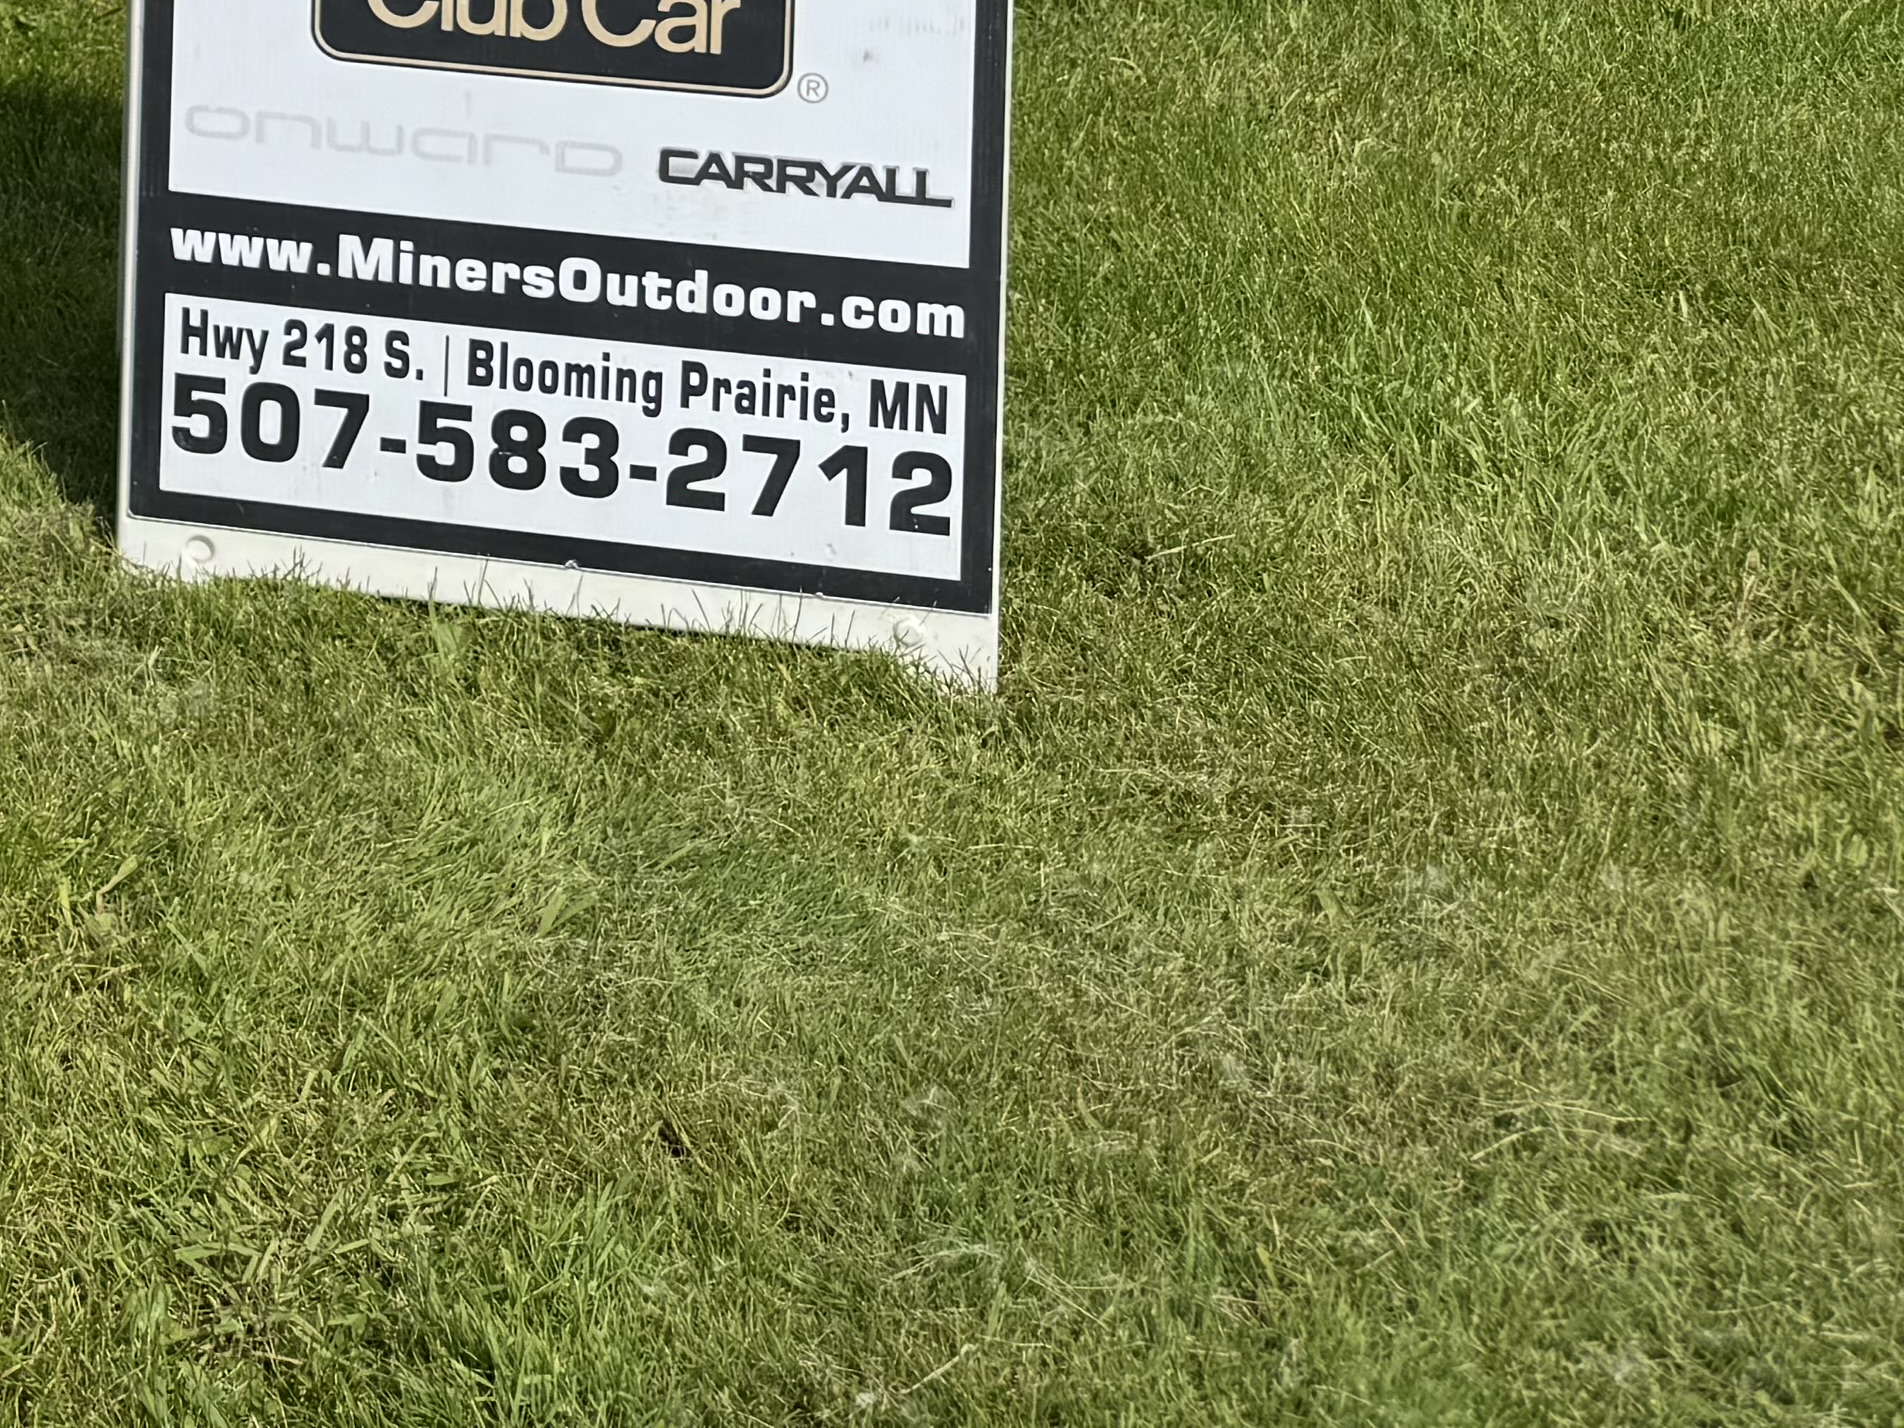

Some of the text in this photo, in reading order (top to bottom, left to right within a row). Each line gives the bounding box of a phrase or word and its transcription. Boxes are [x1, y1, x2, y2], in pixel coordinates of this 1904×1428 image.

[658, 148, 954, 209] CARRYALL
[170, 227, 967, 339] www.MinersOutdoor.com
[180, 307, 269, 375] Hwy
[282, 319, 368, 374] 218
[384, 330, 424, 381] S.
[467, 338, 663, 418] Blooming
[680, 360, 850, 434] Prairie,
[869, 378, 948, 435] MN
[171, 372, 954, 537] 507-583-2712
